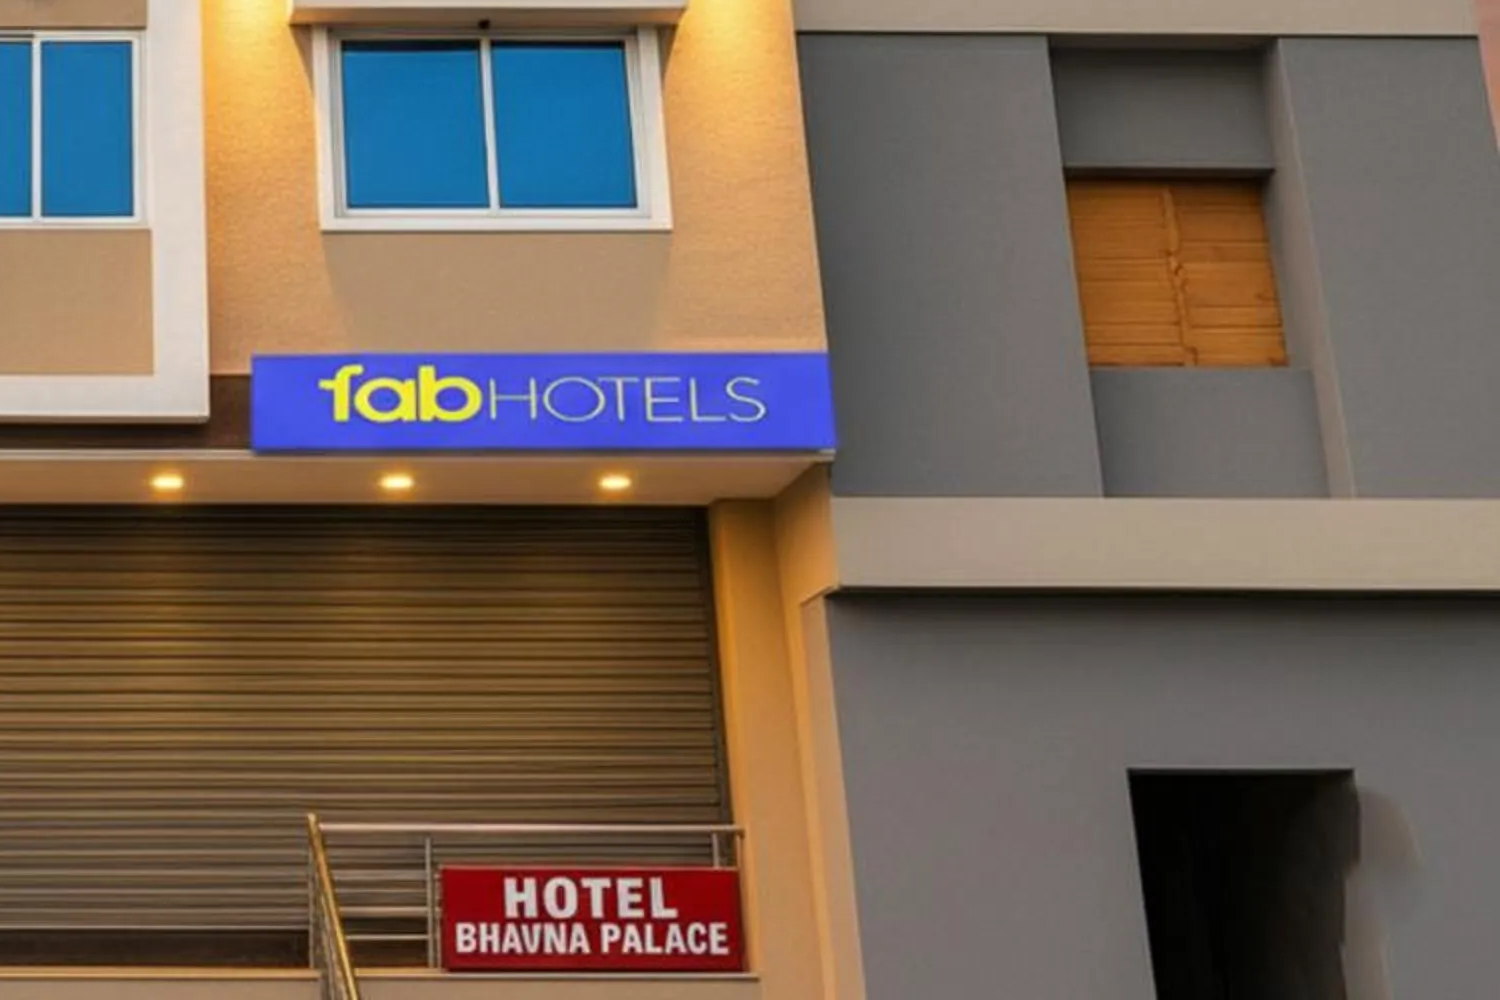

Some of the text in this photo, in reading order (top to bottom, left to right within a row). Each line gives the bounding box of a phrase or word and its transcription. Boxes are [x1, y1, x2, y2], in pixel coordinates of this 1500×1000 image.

[318, 364, 767, 422] fabHOTELS
[503, 876, 679, 919] HOTEL
[455, 923, 730, 955] BHAVNA PALACE
